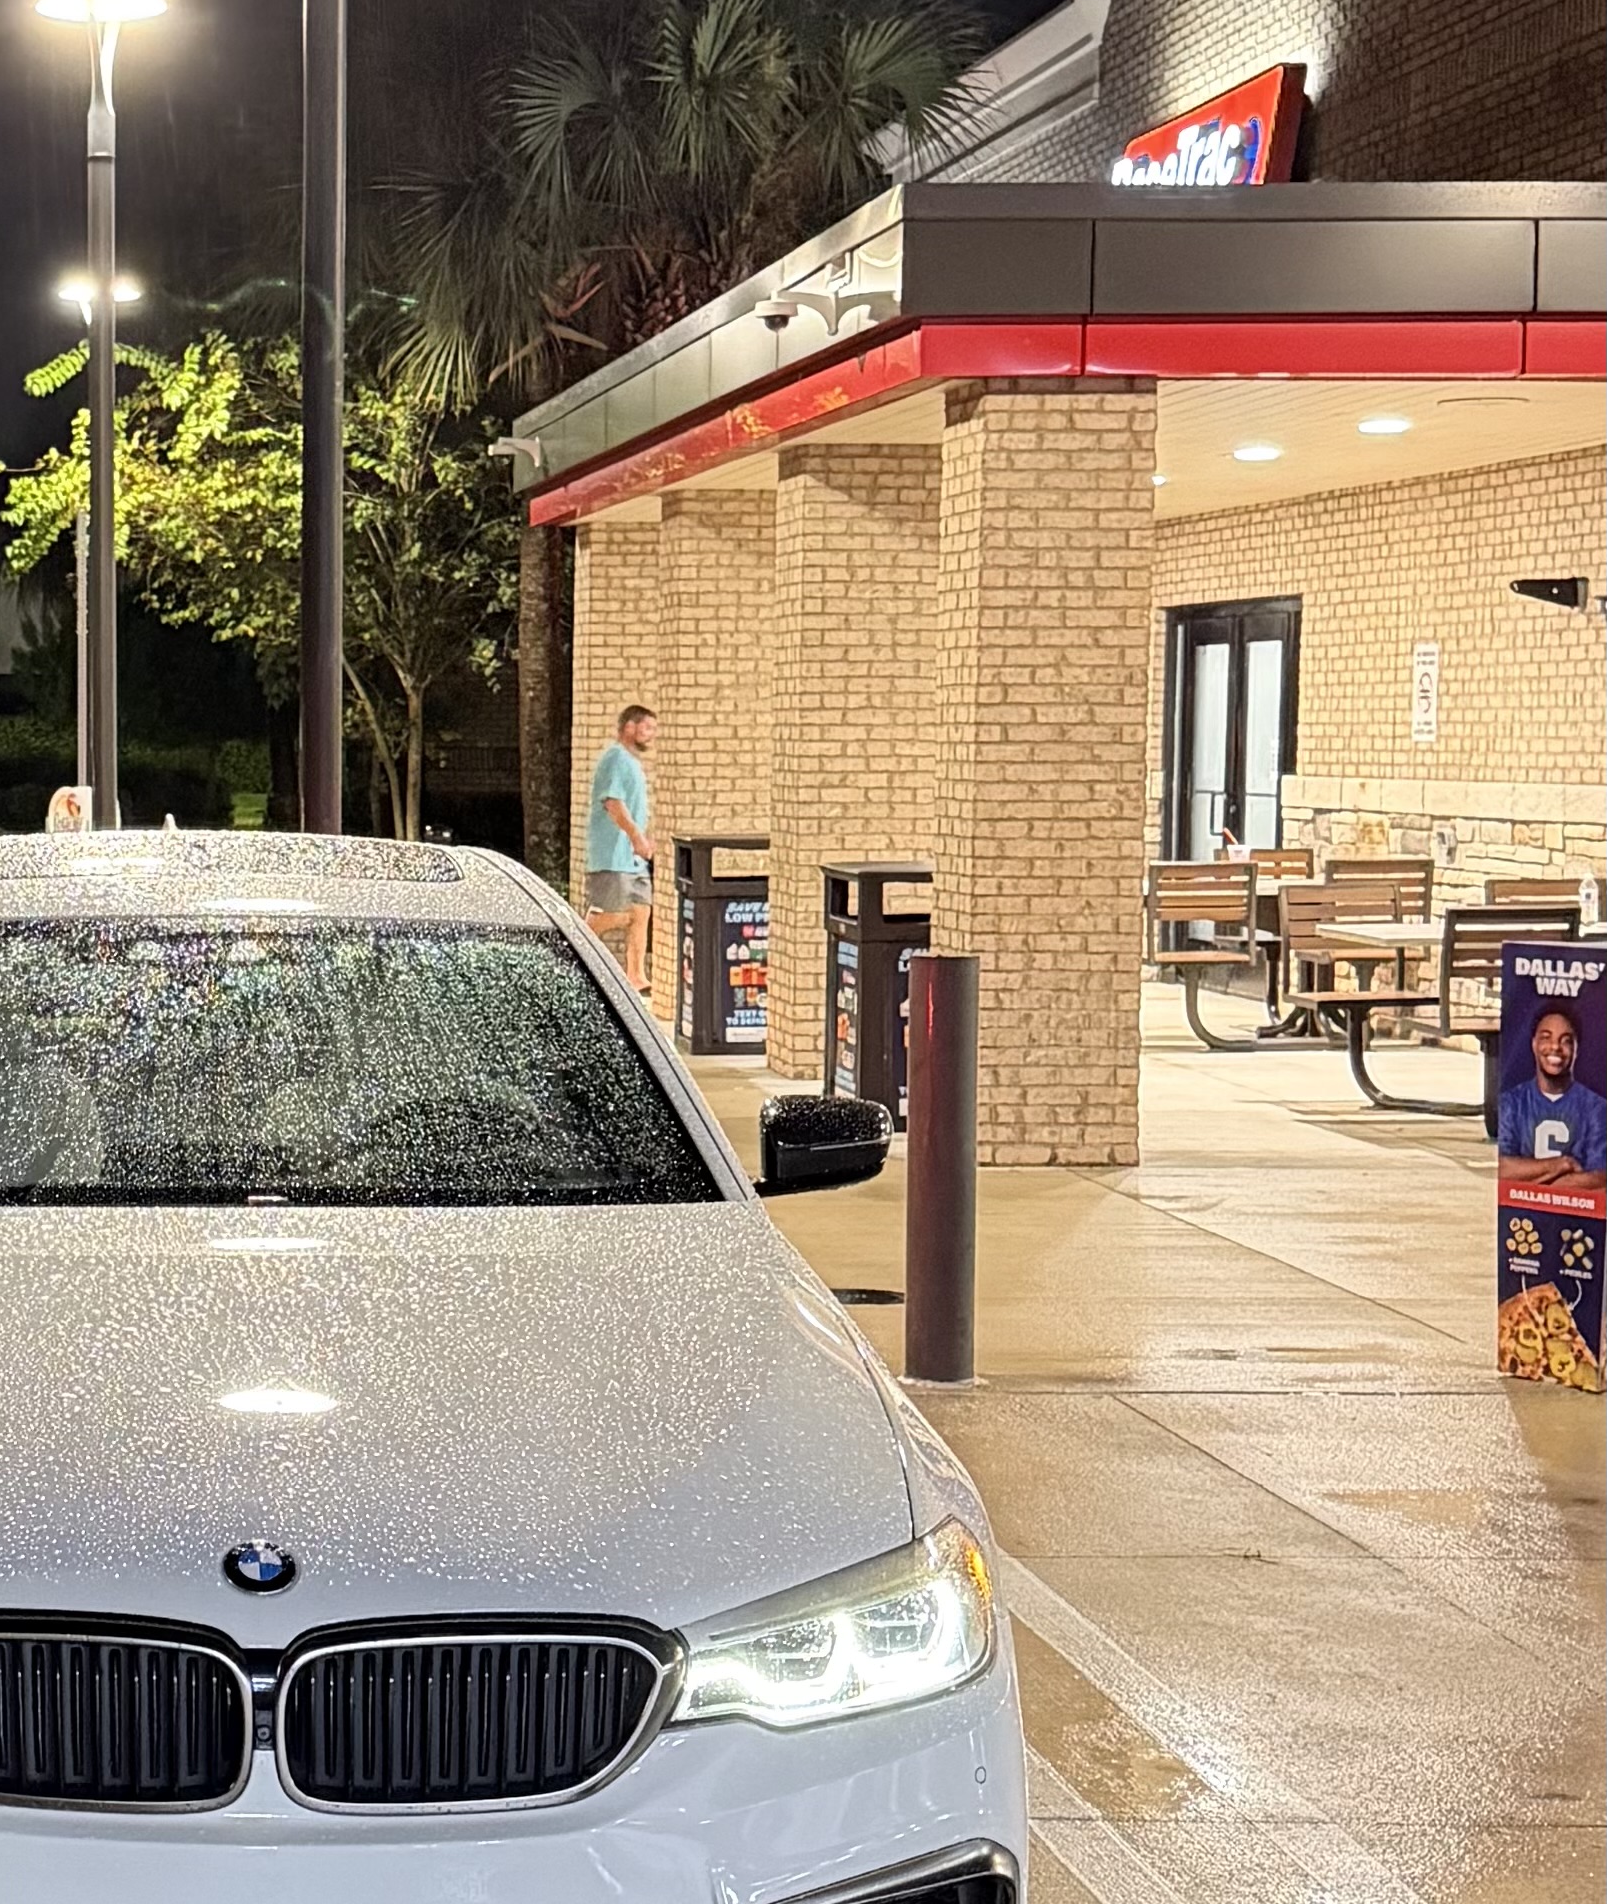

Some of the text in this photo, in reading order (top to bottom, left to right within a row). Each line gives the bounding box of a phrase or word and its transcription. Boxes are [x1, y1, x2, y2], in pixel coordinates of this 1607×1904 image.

[725, 913, 753, 923] LOW
[1515, 957, 1606, 982] DALLAS'
[1536, 976, 1583, 998] WAY
[1509, 1188, 1551, 1205] DALLAS
